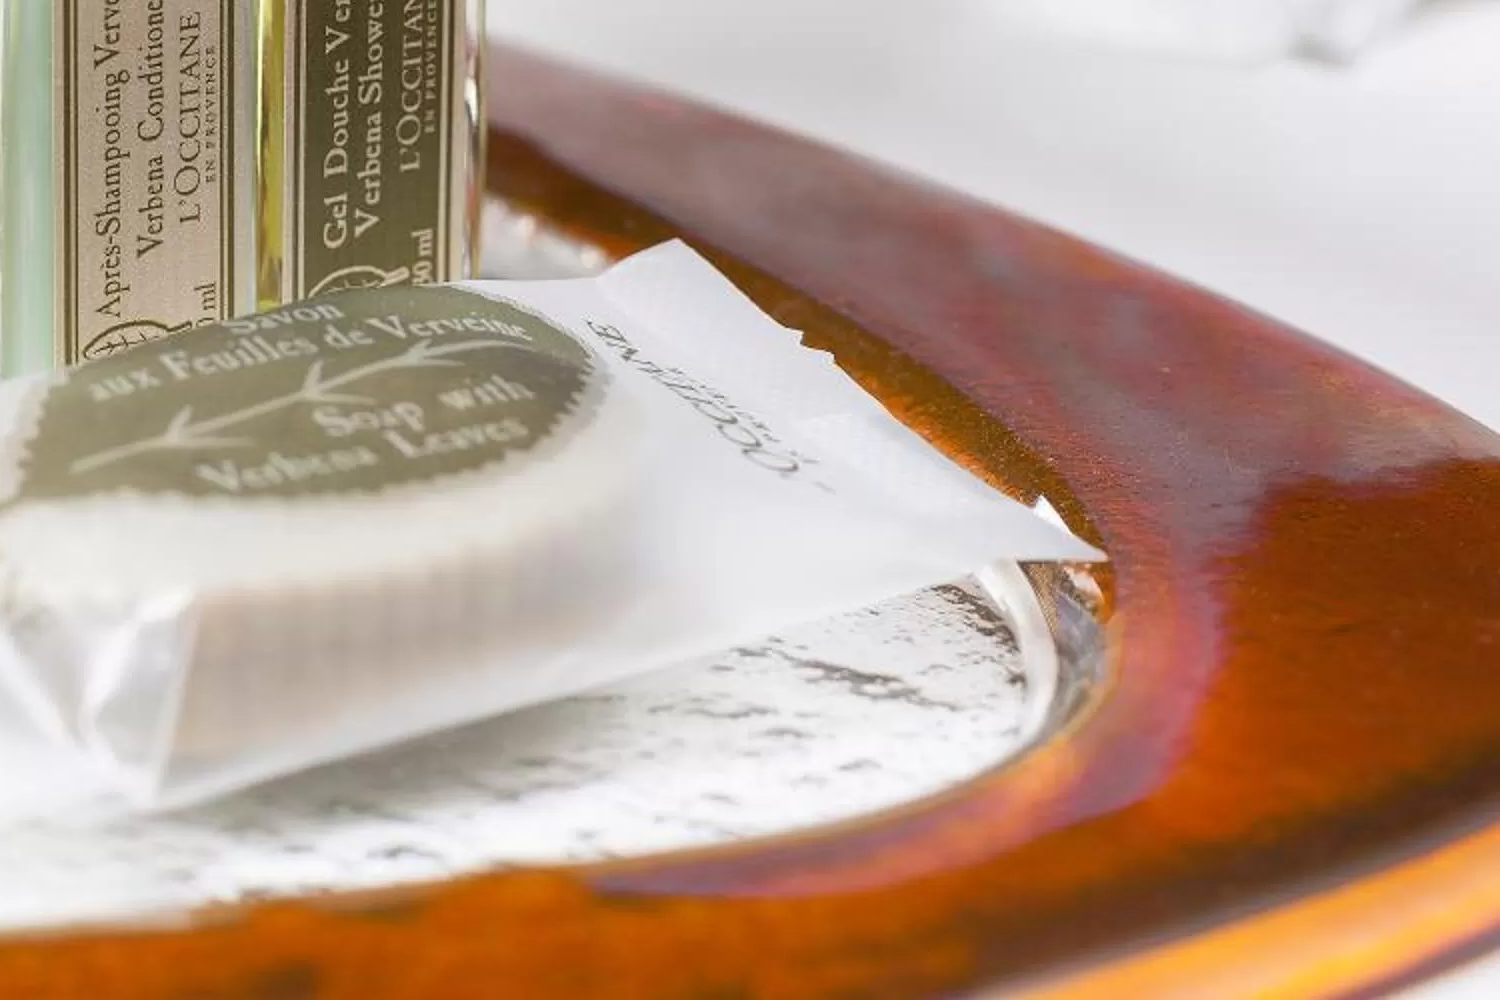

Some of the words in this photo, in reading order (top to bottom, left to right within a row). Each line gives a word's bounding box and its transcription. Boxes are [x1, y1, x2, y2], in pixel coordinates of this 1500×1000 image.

[425, 0, 437, 100] PROVENCE
[173, 11, 201, 224] L'OCCITANE
[205, 44, 217, 150] PROVENCE
[324, 58, 349, 179] Douche
[424, 108, 436, 134] EN
[95, 68, 131, 318] Après-Shampooing
[136, 154, 165, 259] Verbena
[205, 159, 217, 184] EN
[354, 111, 382, 239] Verbena
[323, 192, 348, 249] Gel
[411, 227, 434, 257] ml
[194, 281, 217, 312] ml
[220, 303, 346, 336] Savon
[160, 335, 320, 385] Feuilles
[323, 322, 367, 353] de
[370, 311, 535, 343] Verveine
[310, 400, 427, 437] Soap
[439, 371, 537, 409] with
